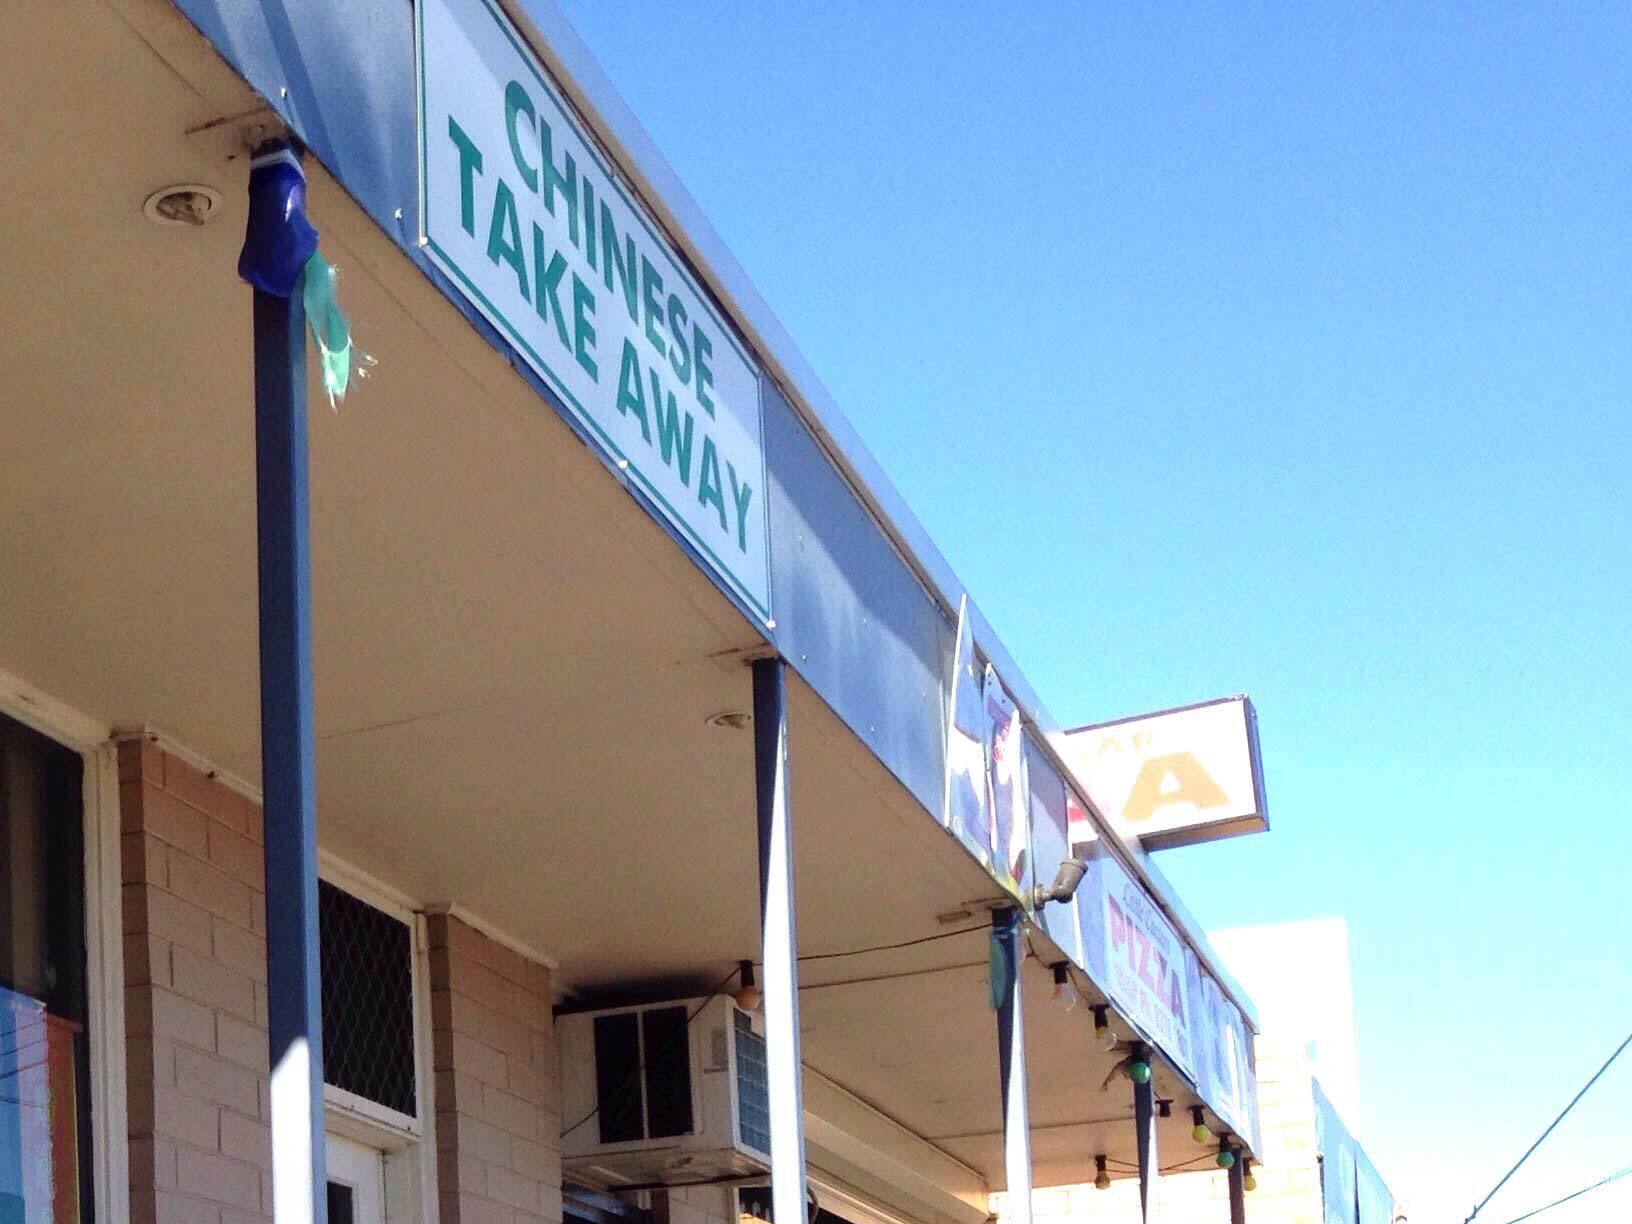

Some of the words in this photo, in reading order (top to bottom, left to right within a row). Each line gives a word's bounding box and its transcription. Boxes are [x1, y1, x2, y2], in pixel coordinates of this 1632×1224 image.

[447, 114, 599, 384] TAKE
[616, 337, 753, 554] AWAY
[504, 79, 715, 425] CHINESE
[1107, 892, 1186, 1030] PIZZA
